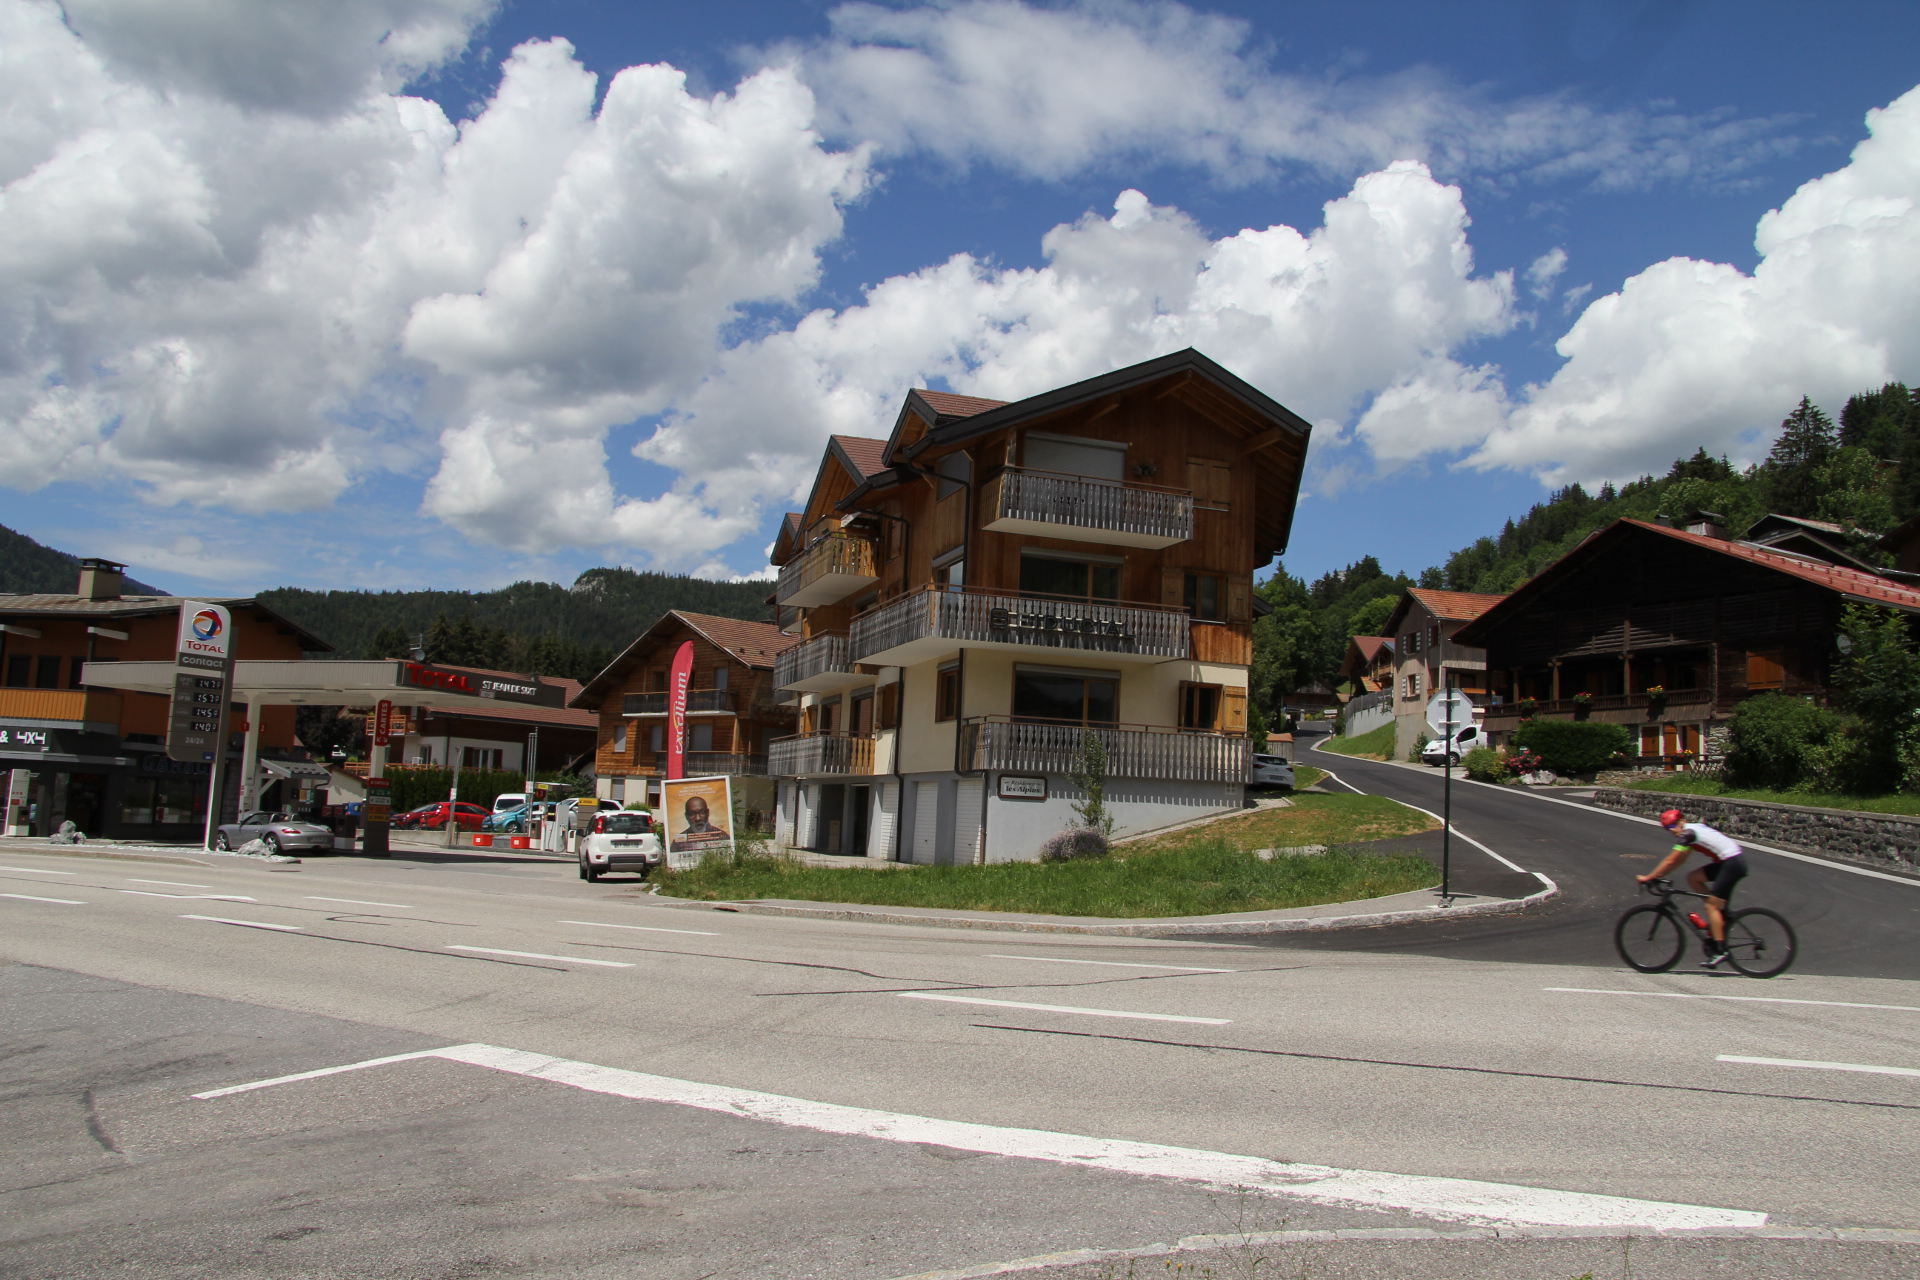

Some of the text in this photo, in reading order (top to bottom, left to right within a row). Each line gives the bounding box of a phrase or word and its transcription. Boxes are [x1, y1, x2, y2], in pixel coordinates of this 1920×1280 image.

[1018, 613, 1136, 638] FIDUCIAL
[187, 640, 224, 653] TOTAL
[182, 656, 223, 668] contact
[405, 663, 475, 692] TOTAL
[482, 680, 492, 690] ST
[492, 682, 510, 692] JEAN
[520, 686, 537, 697] SIXT
[380, 703, 388, 735] CARTES
